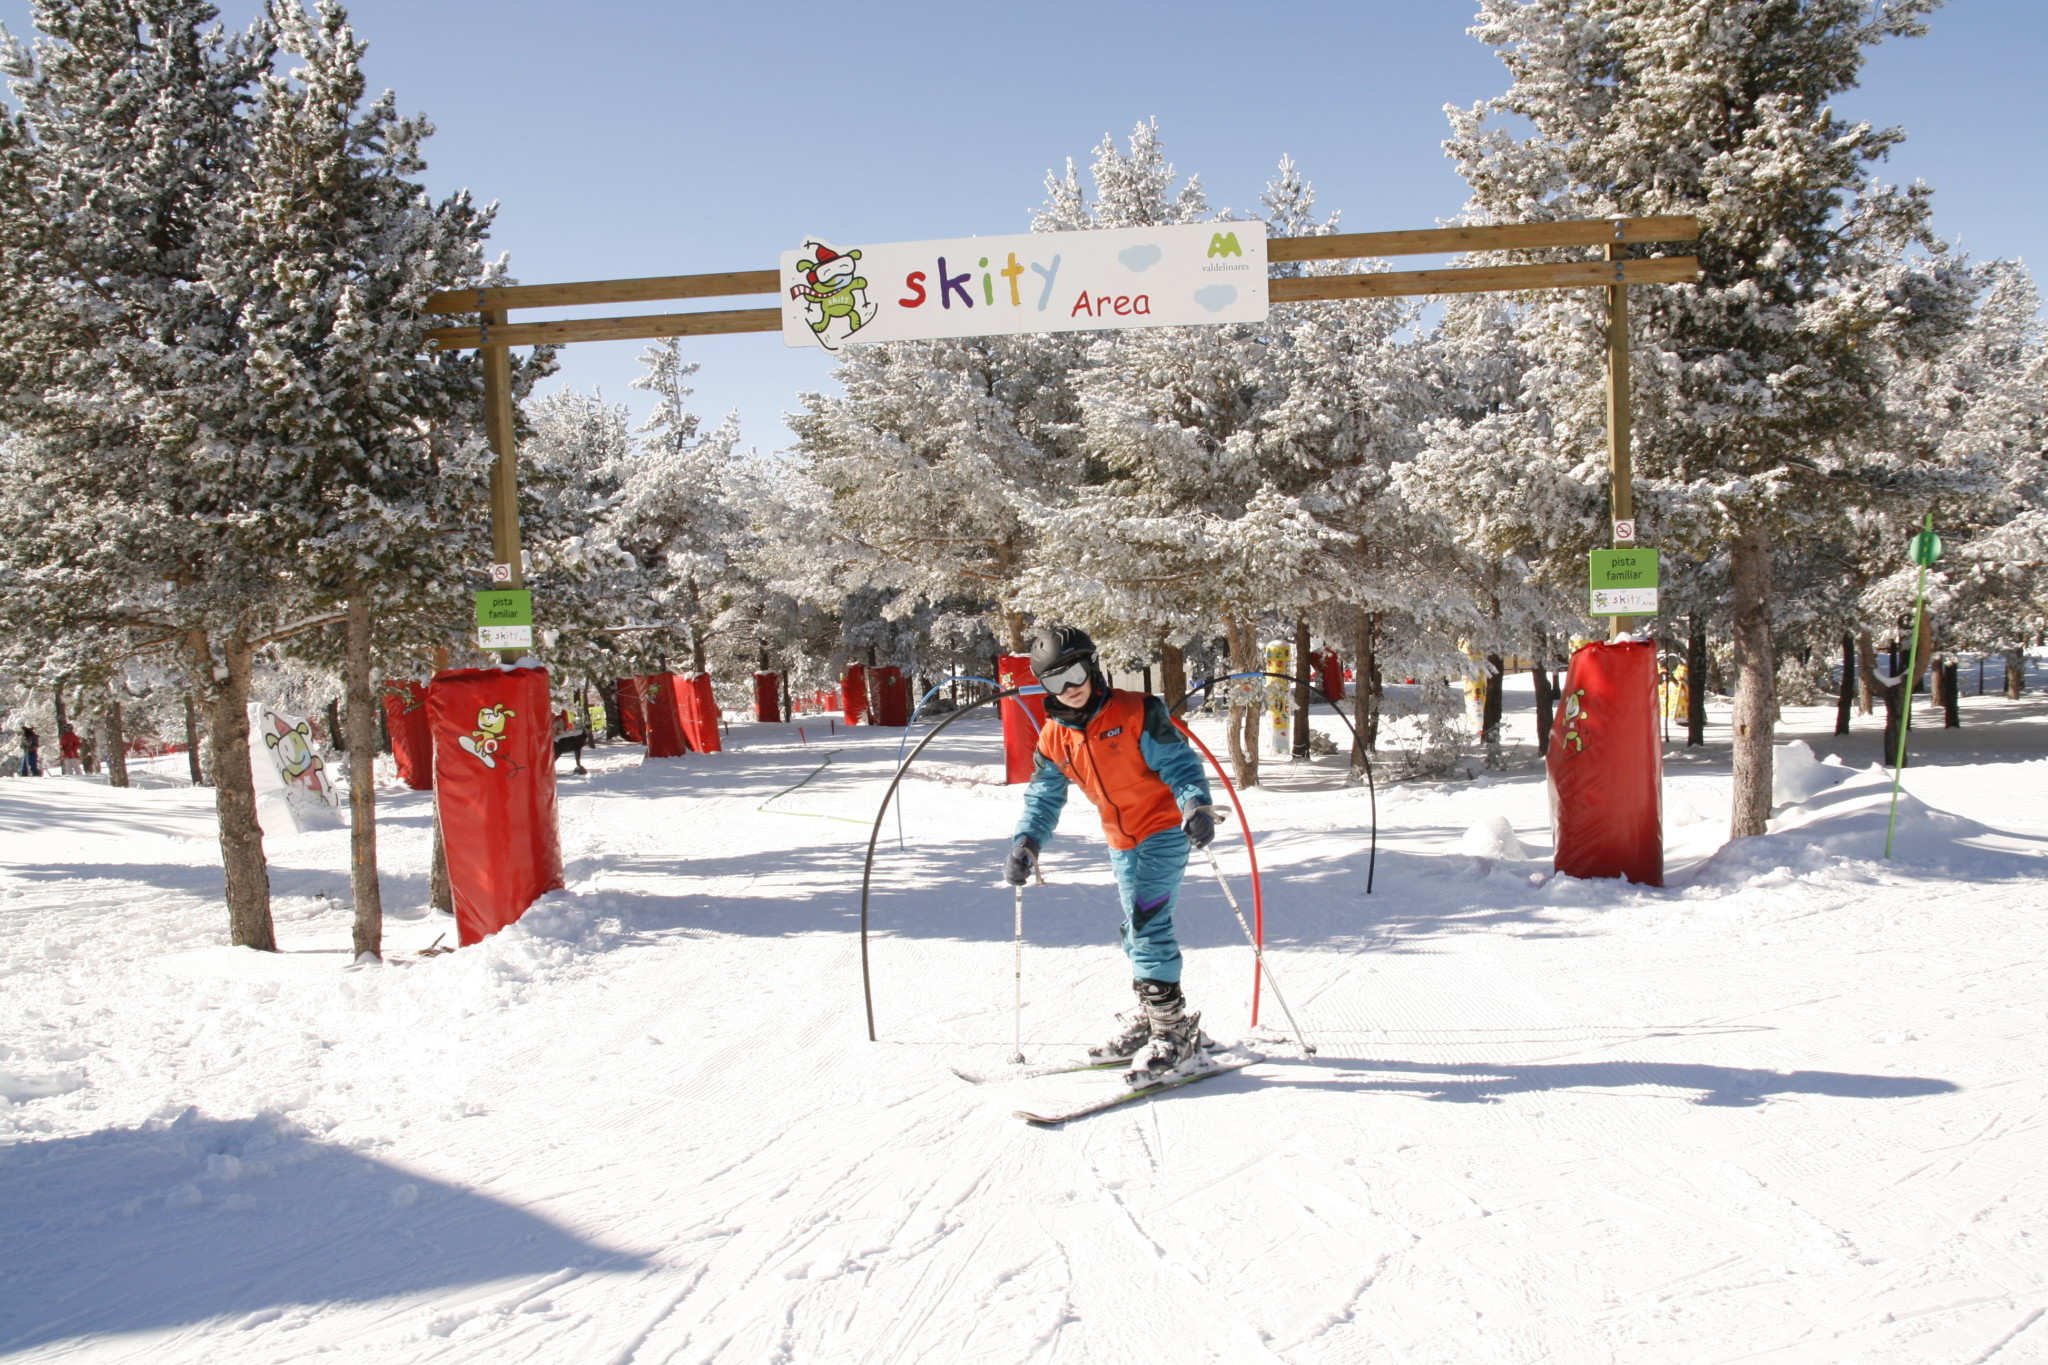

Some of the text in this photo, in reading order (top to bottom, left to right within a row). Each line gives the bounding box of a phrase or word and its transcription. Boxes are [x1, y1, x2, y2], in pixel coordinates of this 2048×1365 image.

[1201, 262, 1250, 272] valdelinares
[898, 252, 1151, 318] skity Area
[828, 296, 849, 305] skity
[1611, 557, 1636, 568] pista
[1606, 570, 1642, 581] familiar
[493, 597, 513, 607] pista
[1612, 594, 1641, 605] skity
[488, 609, 518, 618] familiar
[495, 631, 518, 641] skity
